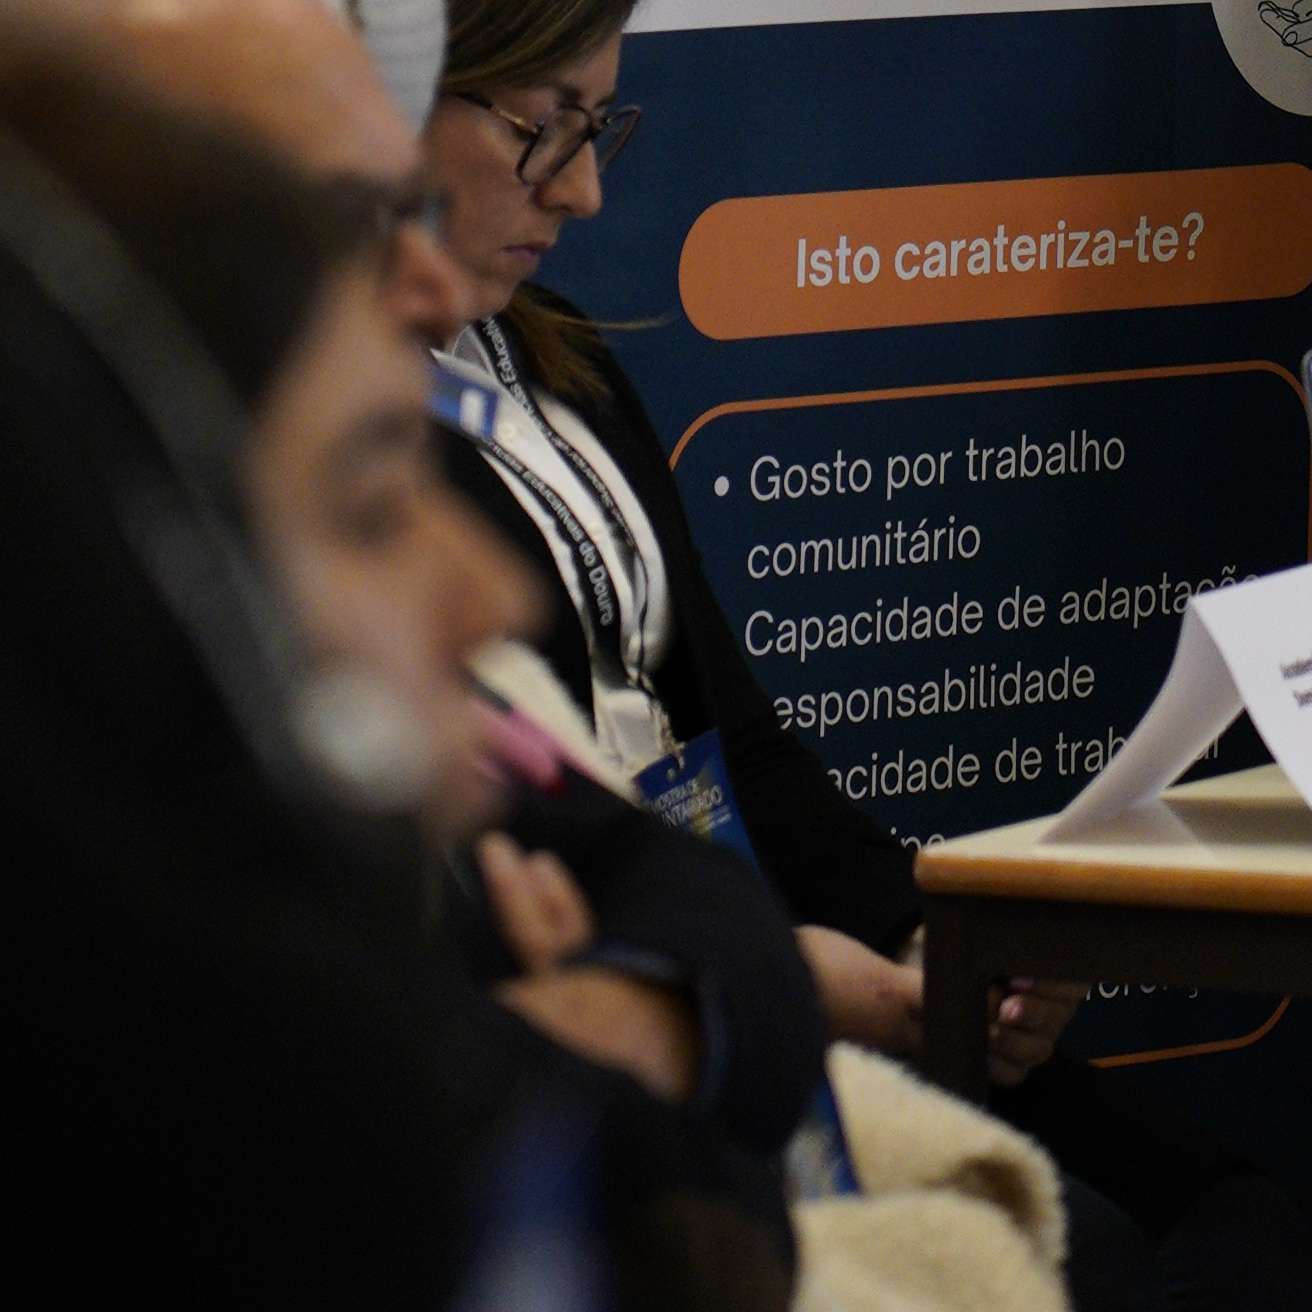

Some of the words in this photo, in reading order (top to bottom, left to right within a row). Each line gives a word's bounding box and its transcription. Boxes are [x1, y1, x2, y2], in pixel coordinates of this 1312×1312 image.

[796, 234, 881, 288] Isto
[894, 211, 1205, 281] carateriza-te?
[749, 448, 872, 502] Gosto
[886, 450, 954, 500] por
[965, 428, 1126, 482] trabalho
[747, 514, 982, 580] comunitário
[588, 564, 615, 627] Douro
[744, 591, 984, 663] Capacidade
[997, 585, 1046, 632] de
[773, 656, 1096, 738] esponsabilidade
[995, 738, 1043, 784] de
